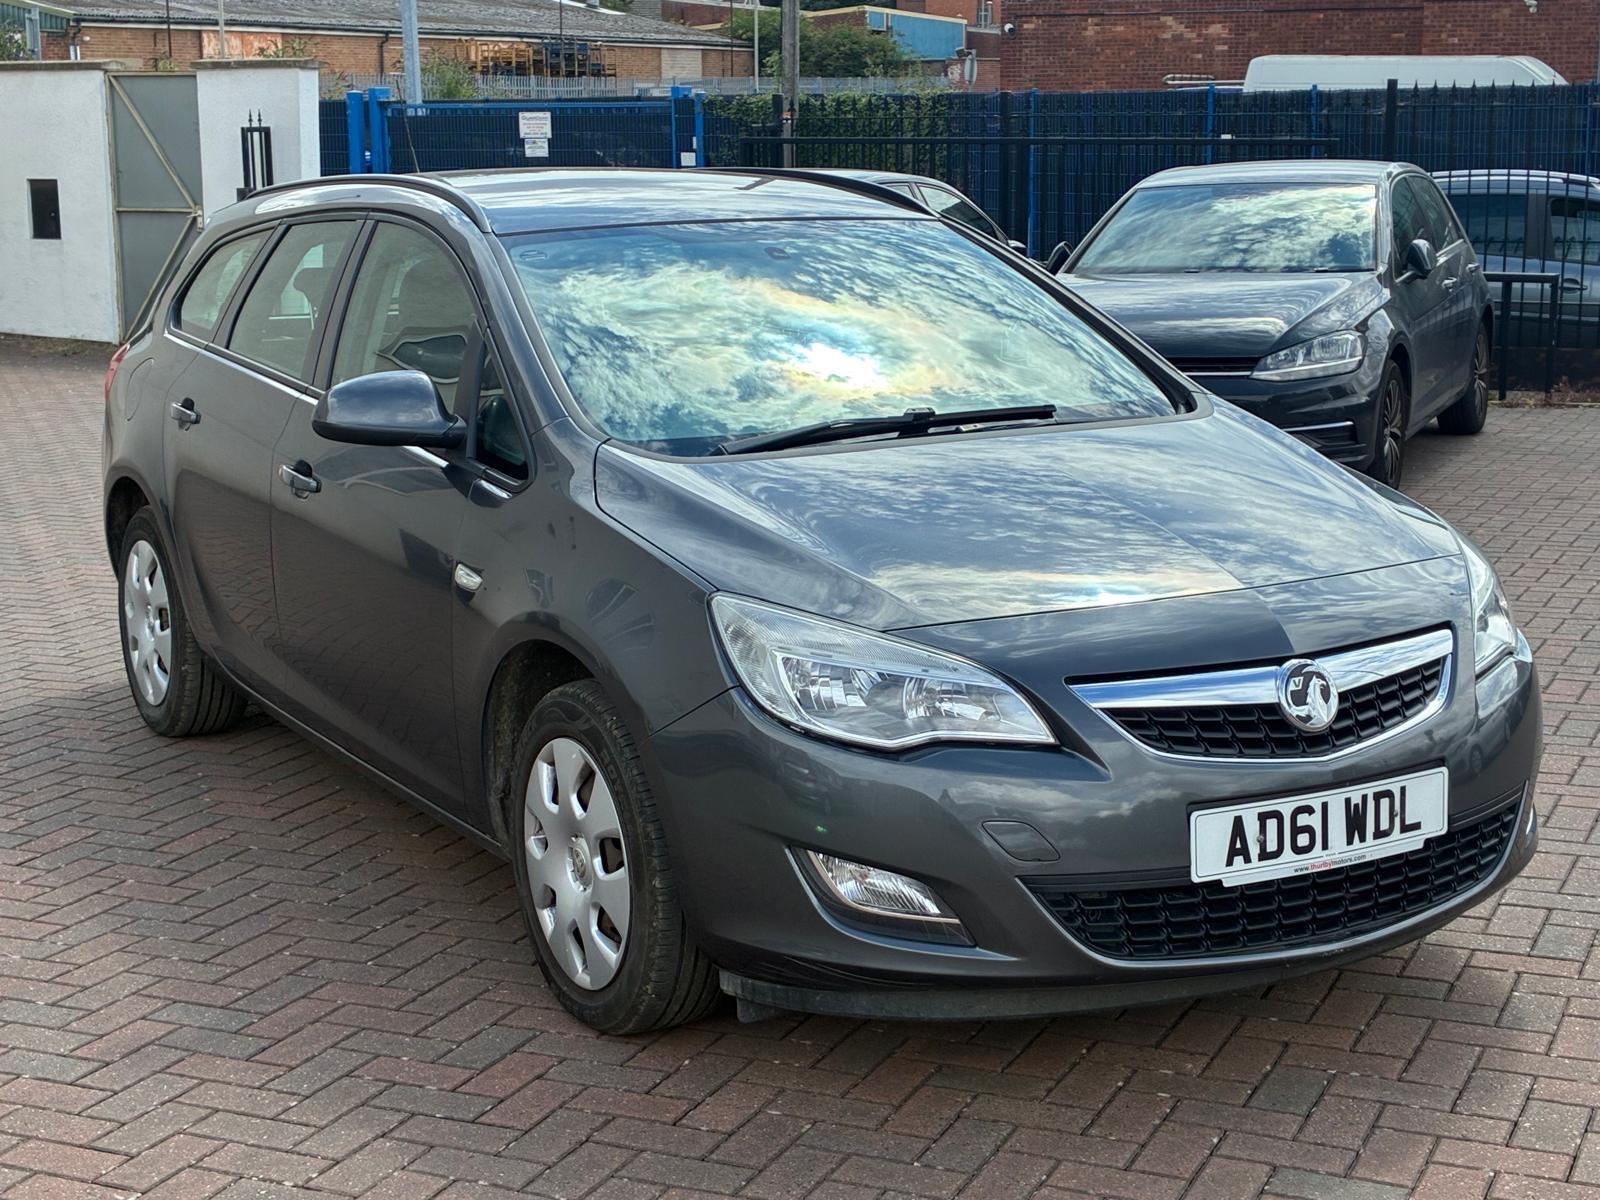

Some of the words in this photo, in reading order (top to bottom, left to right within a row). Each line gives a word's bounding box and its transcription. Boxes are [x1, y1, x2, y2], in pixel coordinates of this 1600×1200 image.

[1225, 801, 1329, 867] AD61
[1344, 785, 1421, 847] WDL
[1294, 854, 1367, 873] www.thurlbymotors.com
